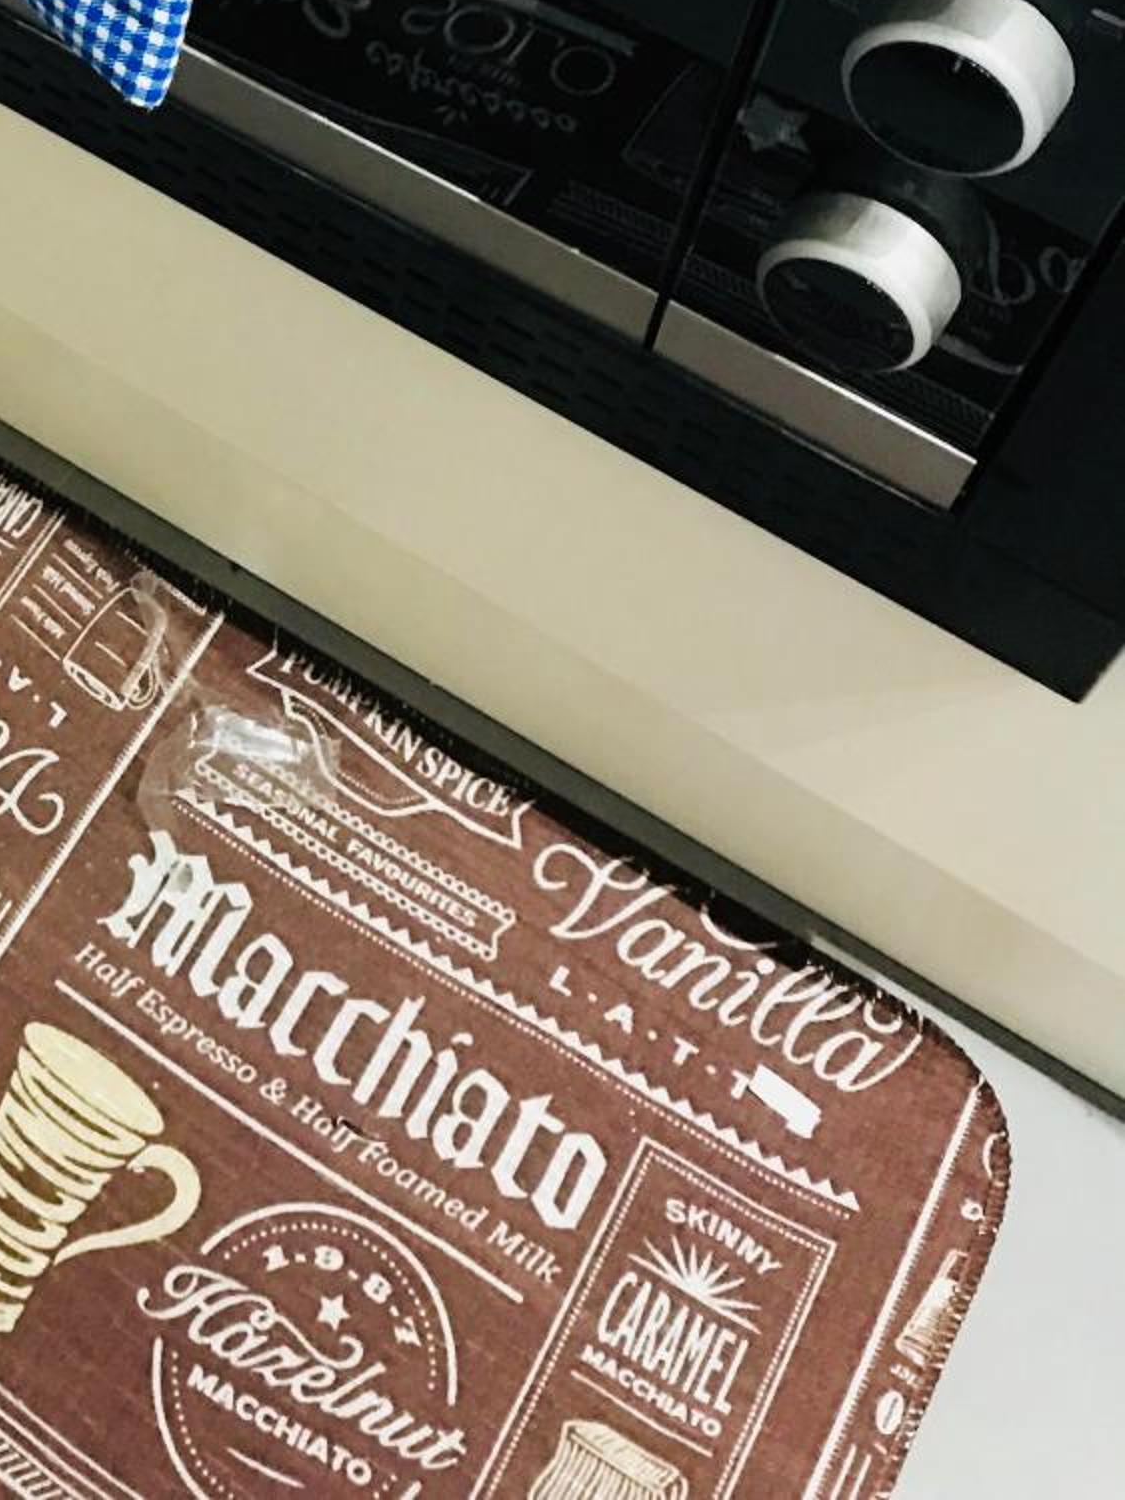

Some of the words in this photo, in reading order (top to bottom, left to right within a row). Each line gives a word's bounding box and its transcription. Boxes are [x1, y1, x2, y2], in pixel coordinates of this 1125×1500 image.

[416, 746, 517, 818] SPICE
[346, 838, 479, 928] FAVOURITES
[96, 829, 608, 1229] Macchiato
[533, 843, 923, 1093] Vanilla
[73, 942, 145, 997] Half
[136, 984, 258, 1083] Espresso
[259, 1076, 288, 1106] &
[290, 1093, 364, 1153] Half
[358, 1132, 492, 1234] Foamed
[485, 1227, 563, 1286] Milk
[663, 1197, 783, 1279] SKINNY
[136, 1264, 468, 1470] Hazelnut
[580, 1343, 724, 1439] MACCHIATO
[595, 1270, 752, 1415] CARAMEL
[186, 1362, 373, 1486] MACCHIATO
